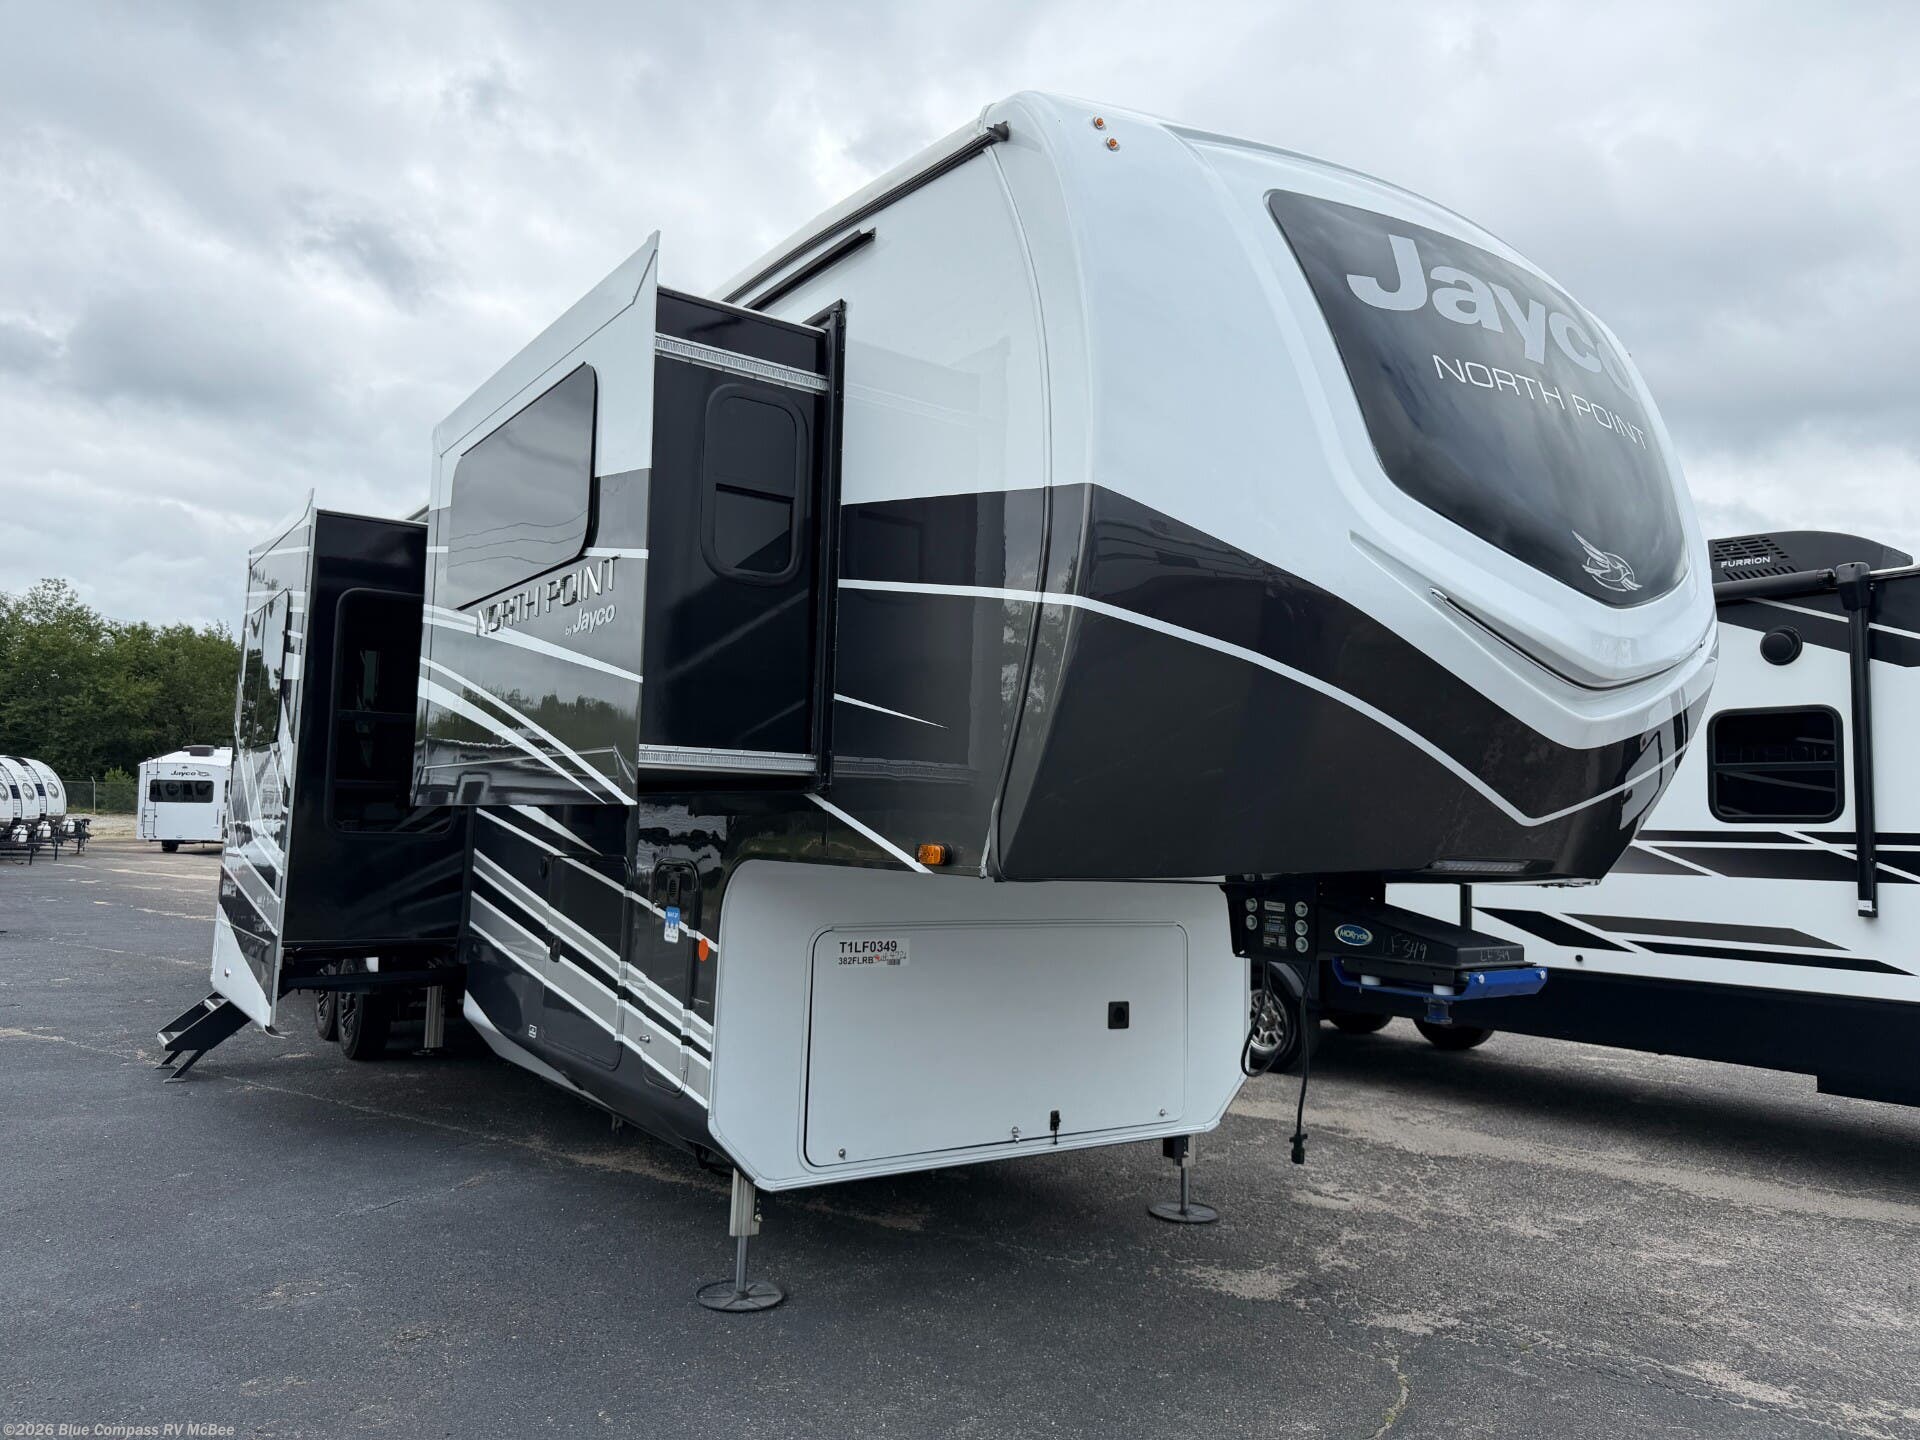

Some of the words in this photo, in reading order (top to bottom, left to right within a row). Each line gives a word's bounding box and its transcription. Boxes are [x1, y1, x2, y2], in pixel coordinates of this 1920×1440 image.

[1432, 354, 1566, 410] NORTH
[1571, 393, 1647, 449] POINT
[1720, 556, 1771, 569] FURRION
[476, 585, 541, 637] NORTH
[546, 554, 621, 613] POINT
[565, 626, 574, 637] by
[573, 604, 617, 634] Jayco
[839, 940, 898, 954] T1LF0349
[838, 956, 875, 965] 382FLRB
